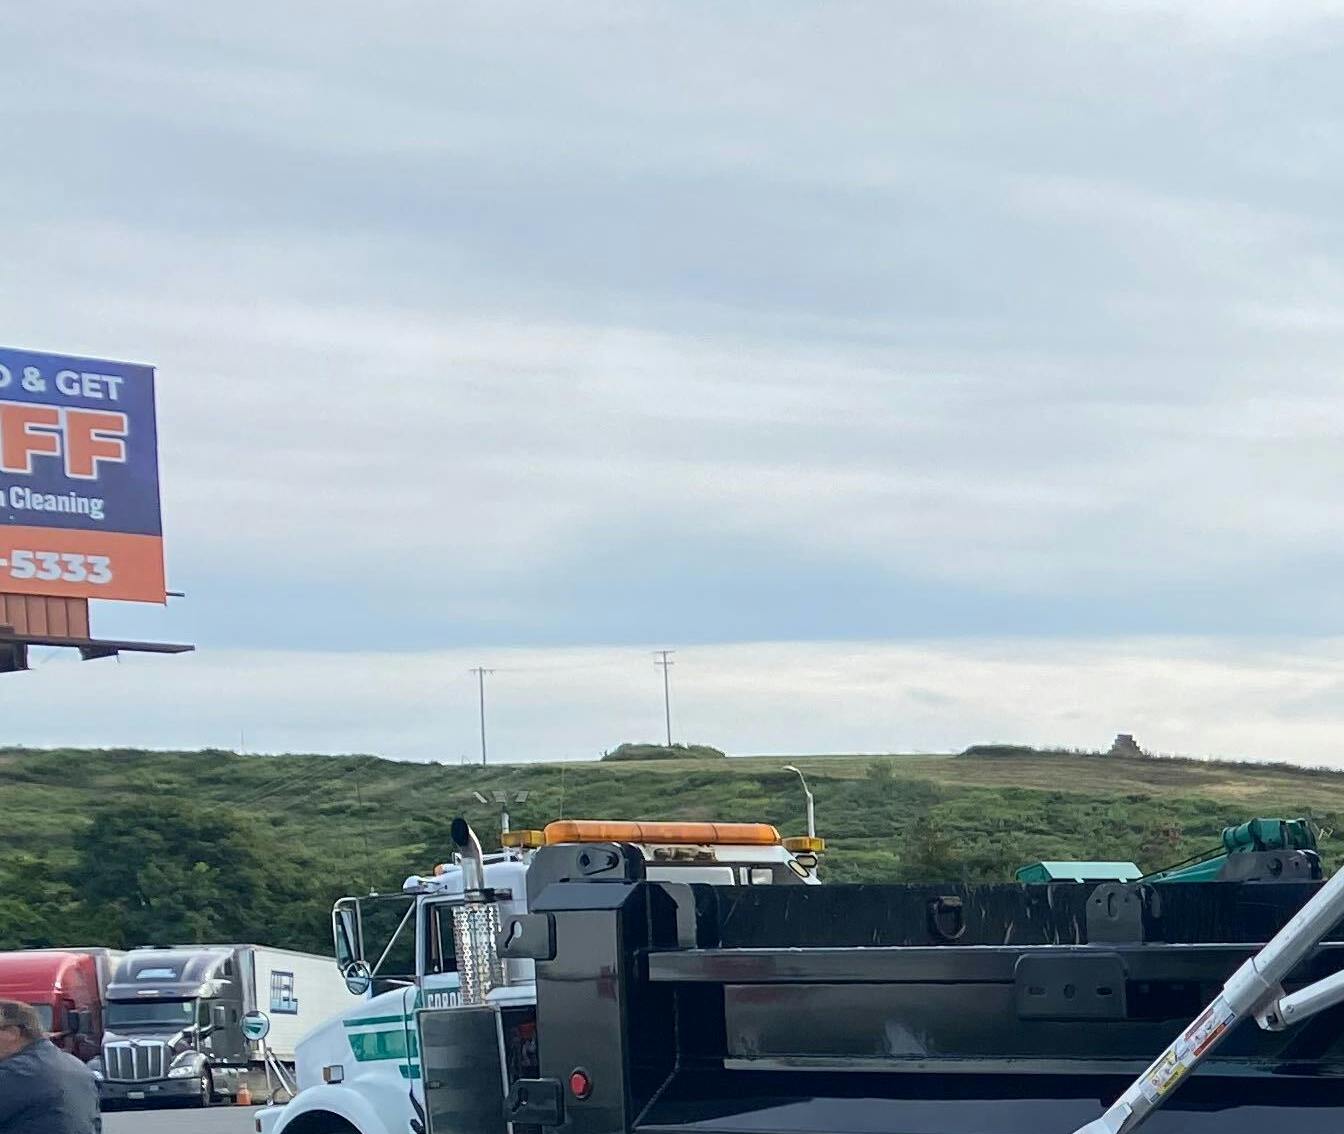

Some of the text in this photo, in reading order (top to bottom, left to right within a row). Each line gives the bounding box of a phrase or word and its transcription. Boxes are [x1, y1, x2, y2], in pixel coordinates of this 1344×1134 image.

[22, 366, 46, 392] &
[55, 370, 124, 400] GET
[9, 486, 105, 520] Cleaning
